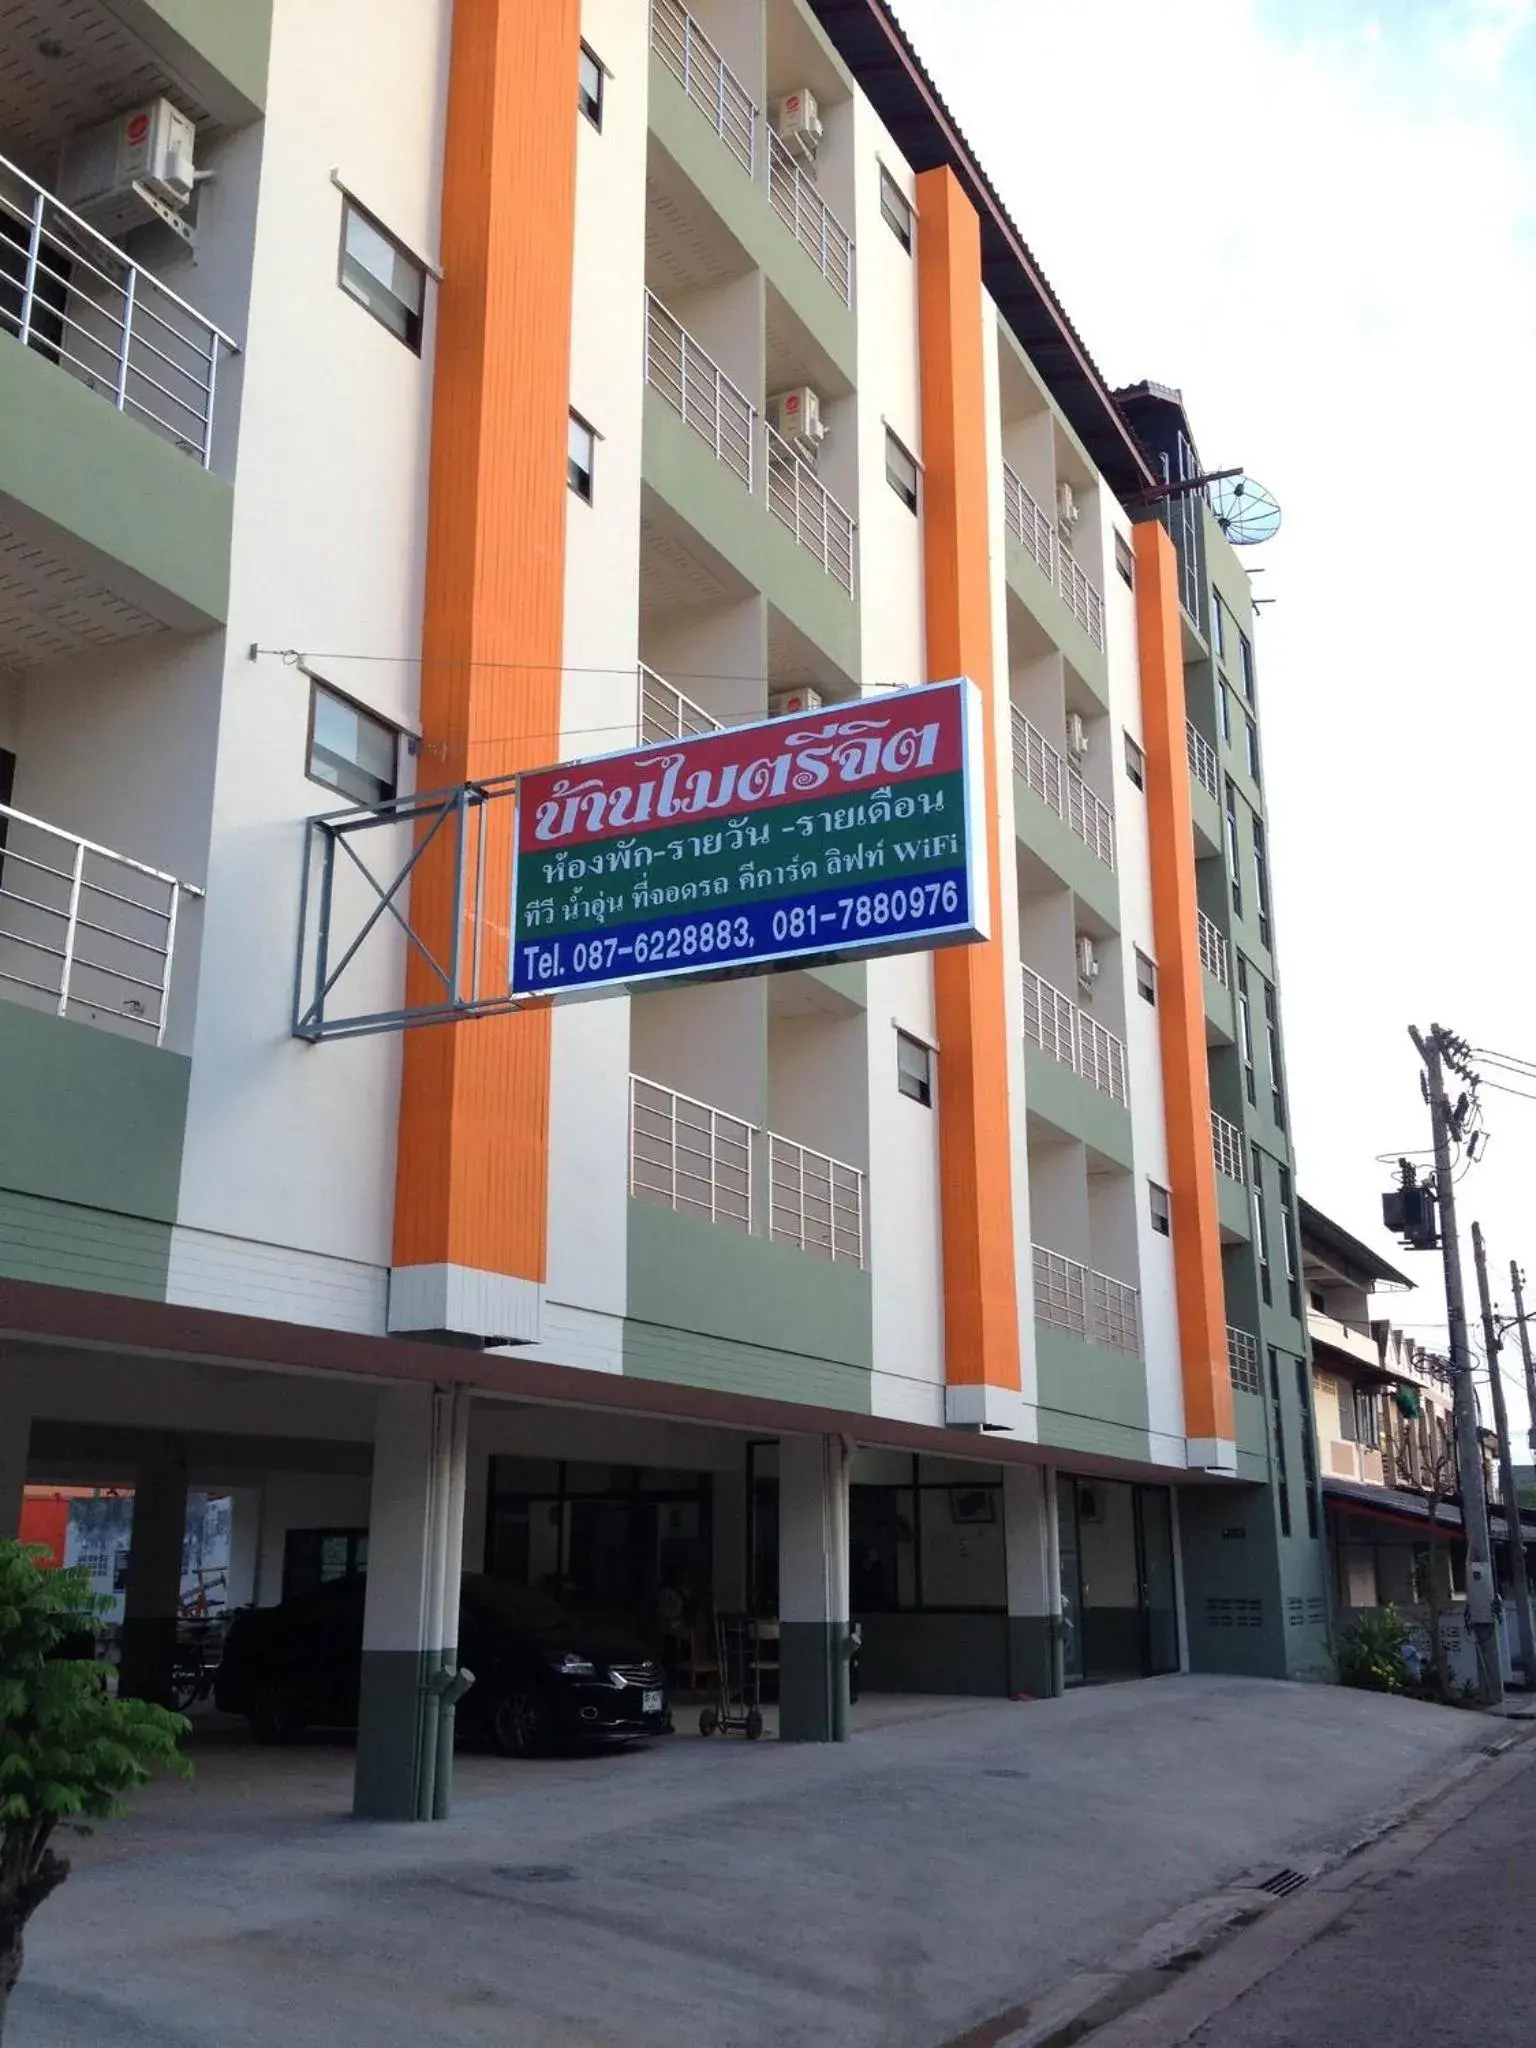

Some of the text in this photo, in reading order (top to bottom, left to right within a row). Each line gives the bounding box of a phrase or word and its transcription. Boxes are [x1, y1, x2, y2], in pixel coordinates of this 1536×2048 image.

[535, 719, 940, 841] บ้านไมตรีจิต
[524, 896, 554, 927] ทีวี
[562, 885, 623, 924] น้ำอุ่น
[632, 874, 729, 909] ที่จอดรถ
[825, 839, 885, 875] ลิฟท์
[893, 833, 958, 863] WiFi
[542, 816, 770, 884] ห้องพัก-รายวัน
[523, 880, 958, 981] Tel. 087-6228883, 081-7880976
